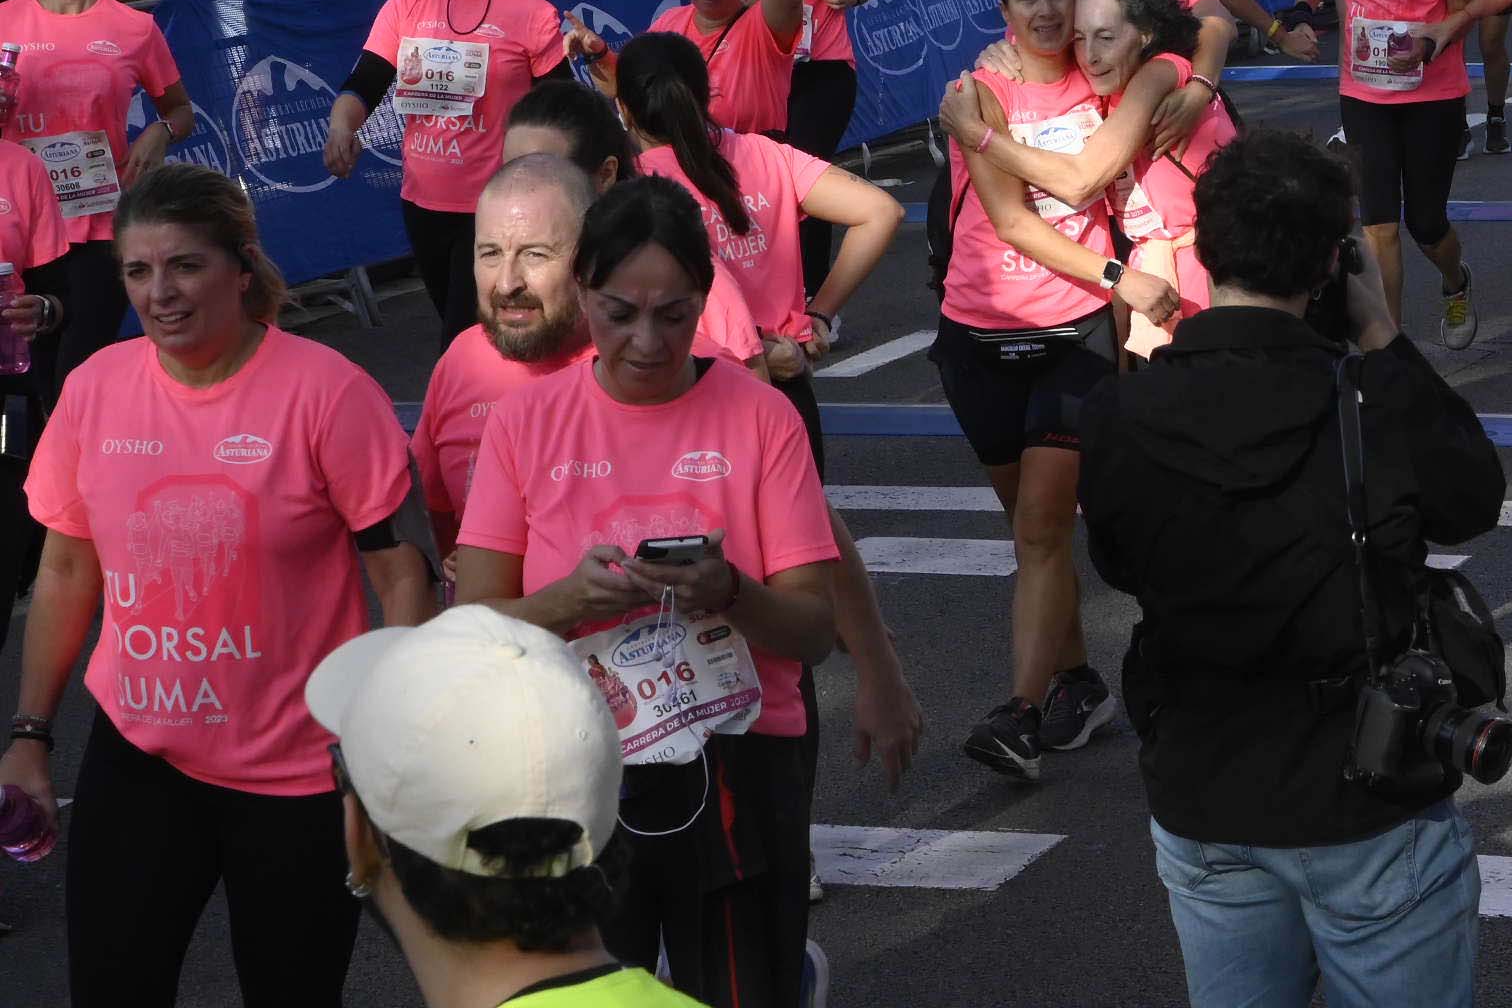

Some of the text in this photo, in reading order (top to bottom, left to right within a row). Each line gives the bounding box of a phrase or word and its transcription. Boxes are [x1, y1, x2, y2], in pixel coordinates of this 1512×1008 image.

[1372, 47, 1388, 57] 01
[425, 69, 455, 82] 016
[430, 83, 449, 91] 1122
[16, 113, 45, 132] TU
[411, 132, 463, 157] SUMA
[49, 166, 82, 182] 016
[718, 233, 768, 262] MUJER
[102, 438, 164, 456] OYSHO
[217, 445, 270, 458] ASTURIANA
[550, 460, 612, 482] OYSHO
[106, 570, 136, 608] TU
[636, 660, 697, 700] 016
[621, 727, 666, 755] CARRERA
[665, 719, 681, 731] DE
[695, 701, 728, 719] MUJER
